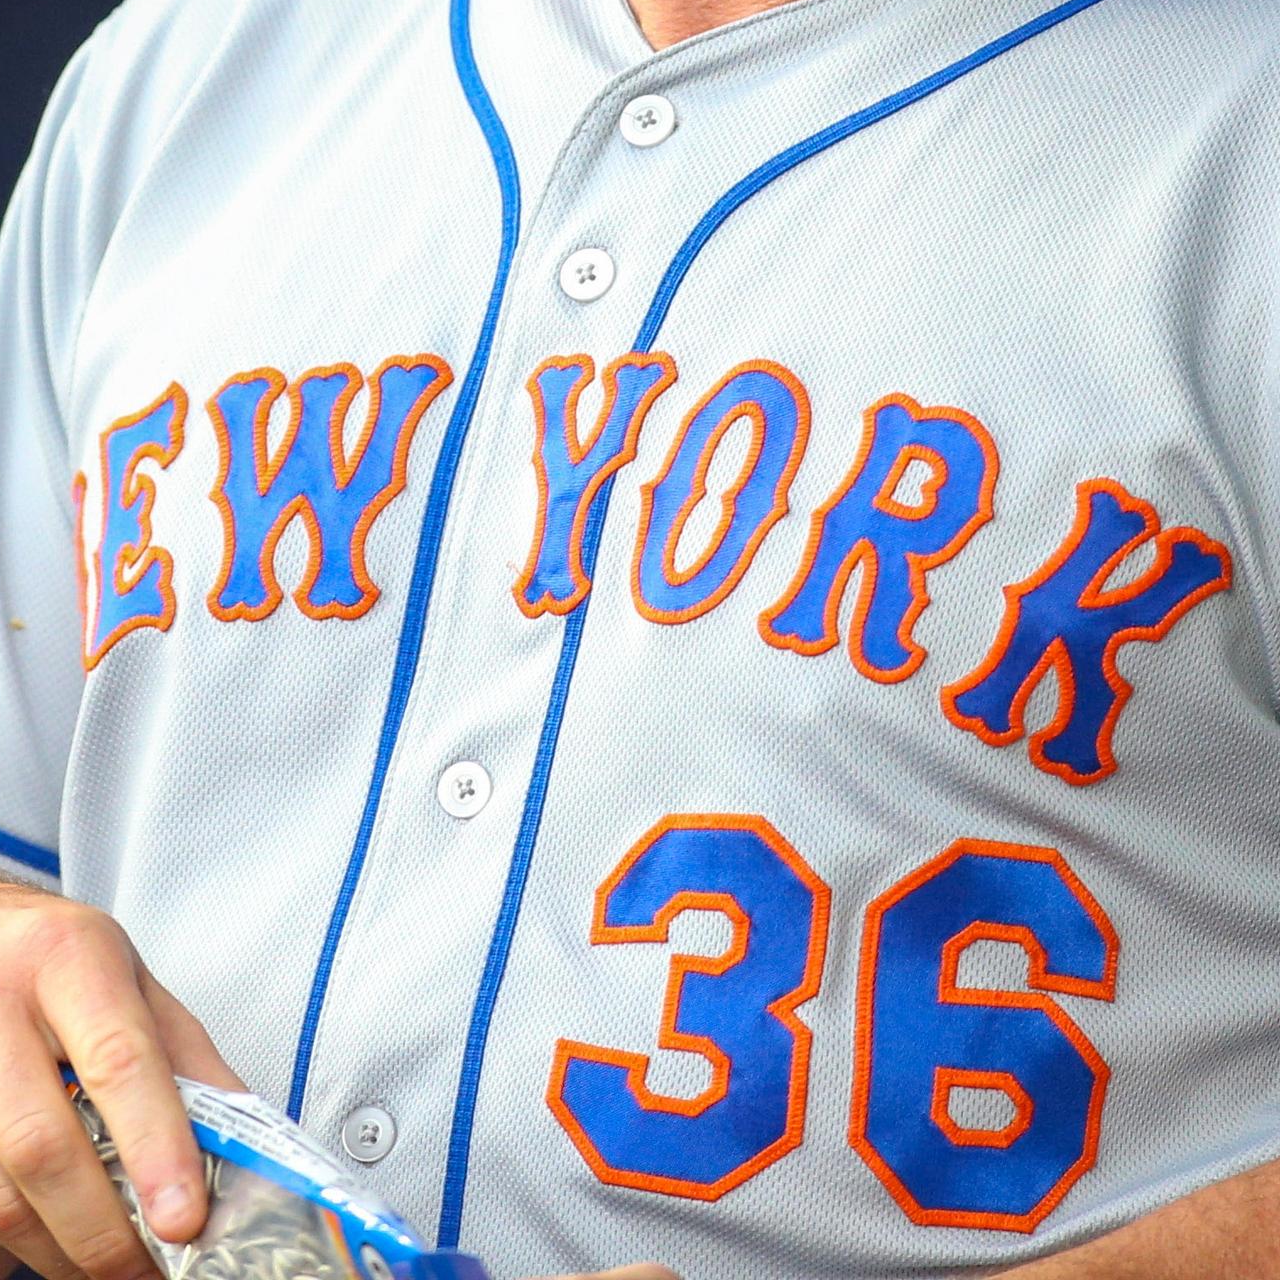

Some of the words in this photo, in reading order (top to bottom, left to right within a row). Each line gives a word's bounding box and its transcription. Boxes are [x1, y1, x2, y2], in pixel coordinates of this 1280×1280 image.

[72, 352, 455, 678] EW
[512, 351, 1233, 786] YORK
[545, 812, 1120, 1235] 36
